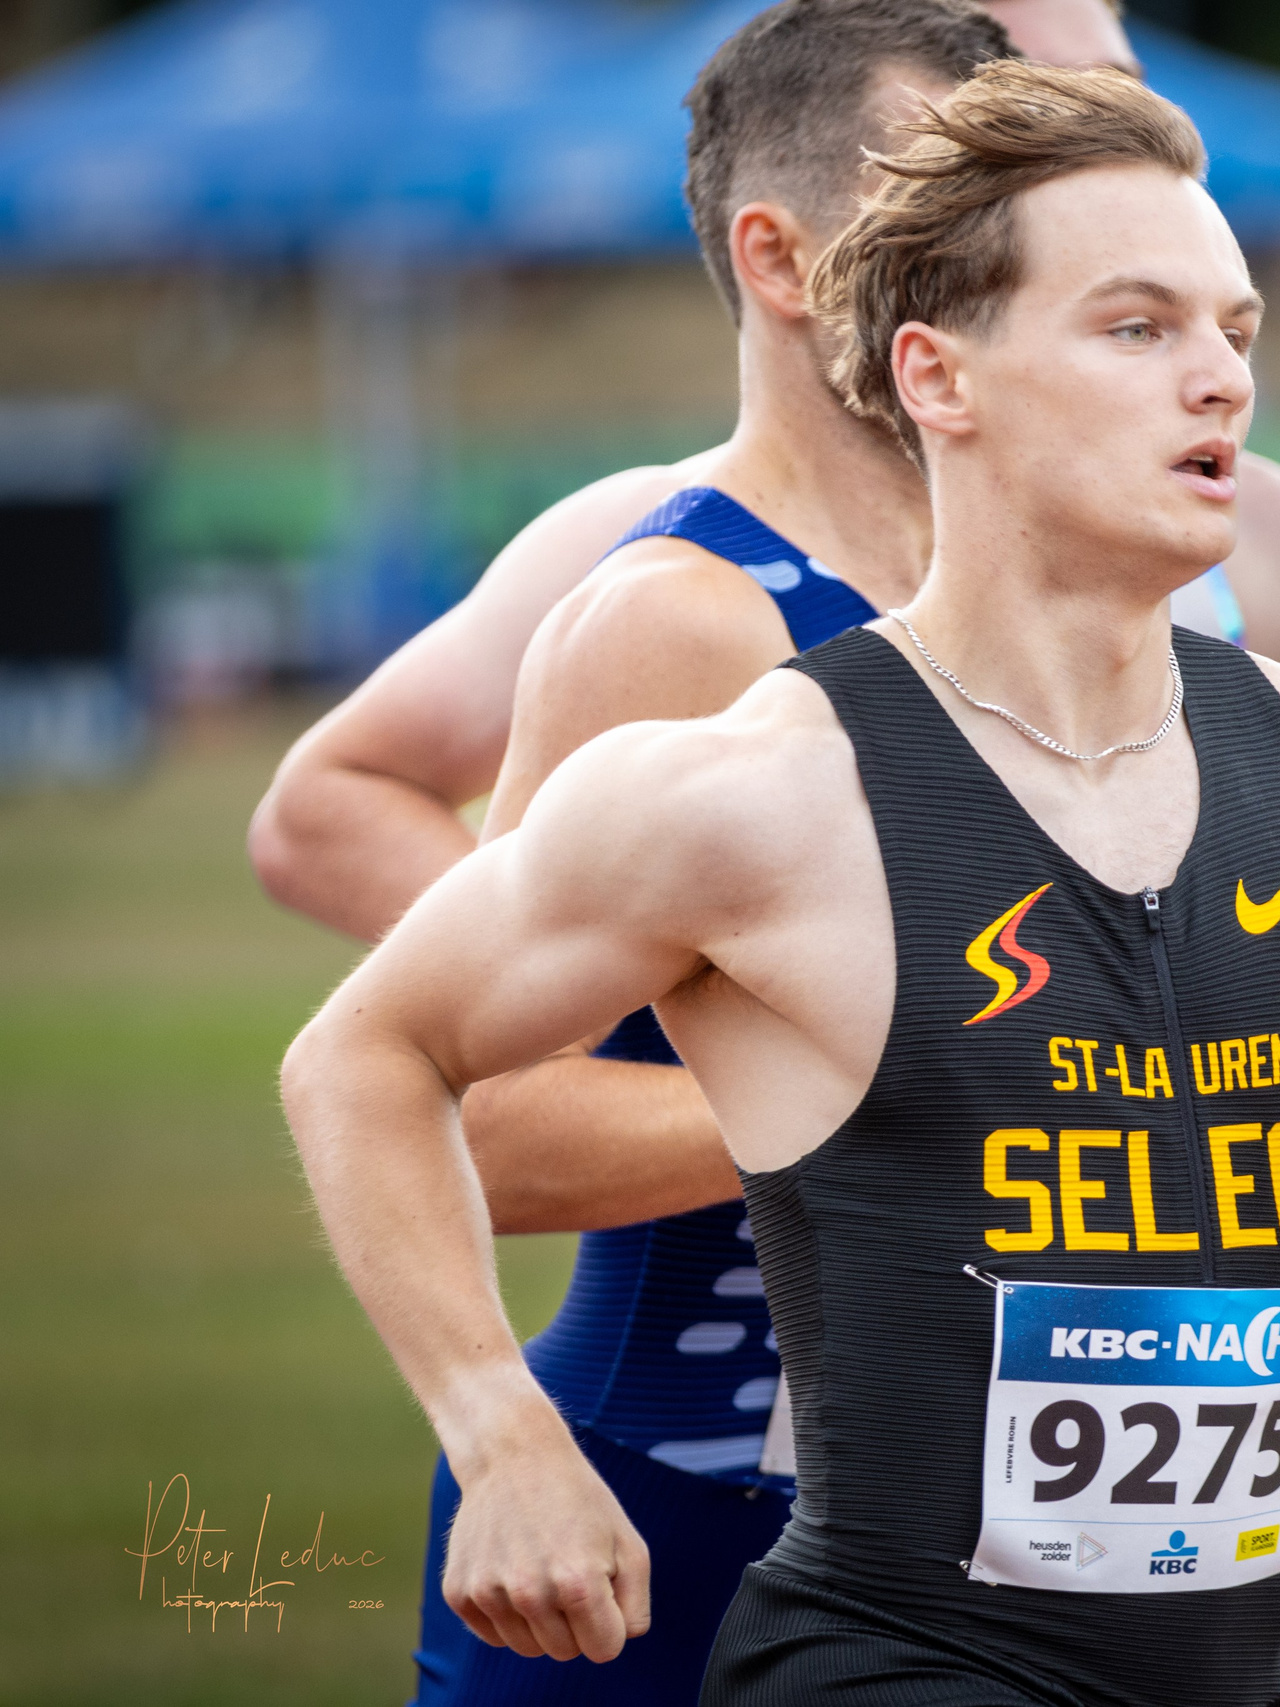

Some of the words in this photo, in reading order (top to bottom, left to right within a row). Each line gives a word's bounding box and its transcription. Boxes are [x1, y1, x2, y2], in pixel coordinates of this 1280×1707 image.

[1008, 1416, 1017, 1442] ROBIN
[1005, 1443, 1015, 1484] LEFEBVRE
[1029, 1540, 1072, 1551] heusden
[1040, 1551, 1072, 1561] zolder
[1149, 1558, 1198, 1575] KBC
